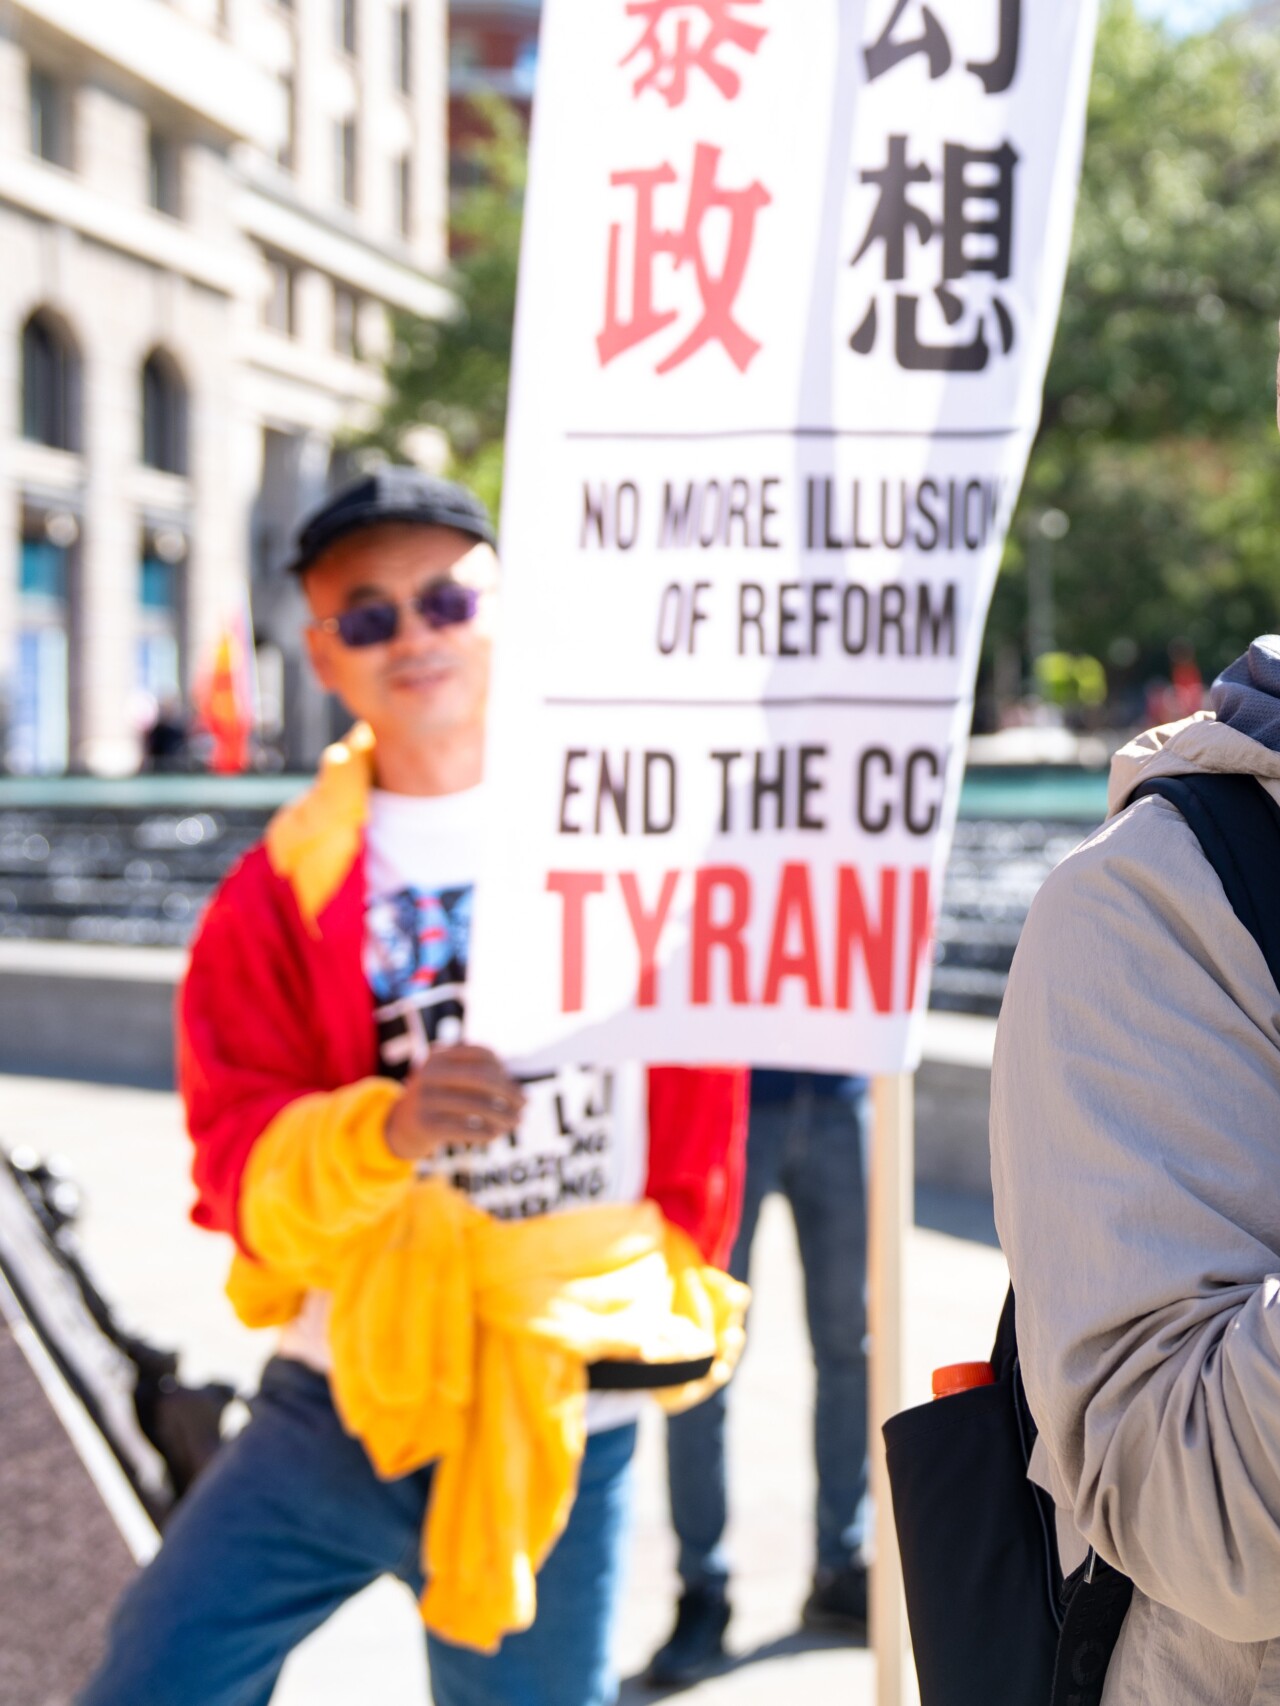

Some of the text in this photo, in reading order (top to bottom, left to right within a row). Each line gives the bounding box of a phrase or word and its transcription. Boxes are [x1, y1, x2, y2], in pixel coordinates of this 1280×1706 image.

[580, 480, 640, 550] NO
[658, 477, 781, 550] MORE
[656, 581, 957, 657] OF REFORM
[557, 746, 946, 835] END THE CC
